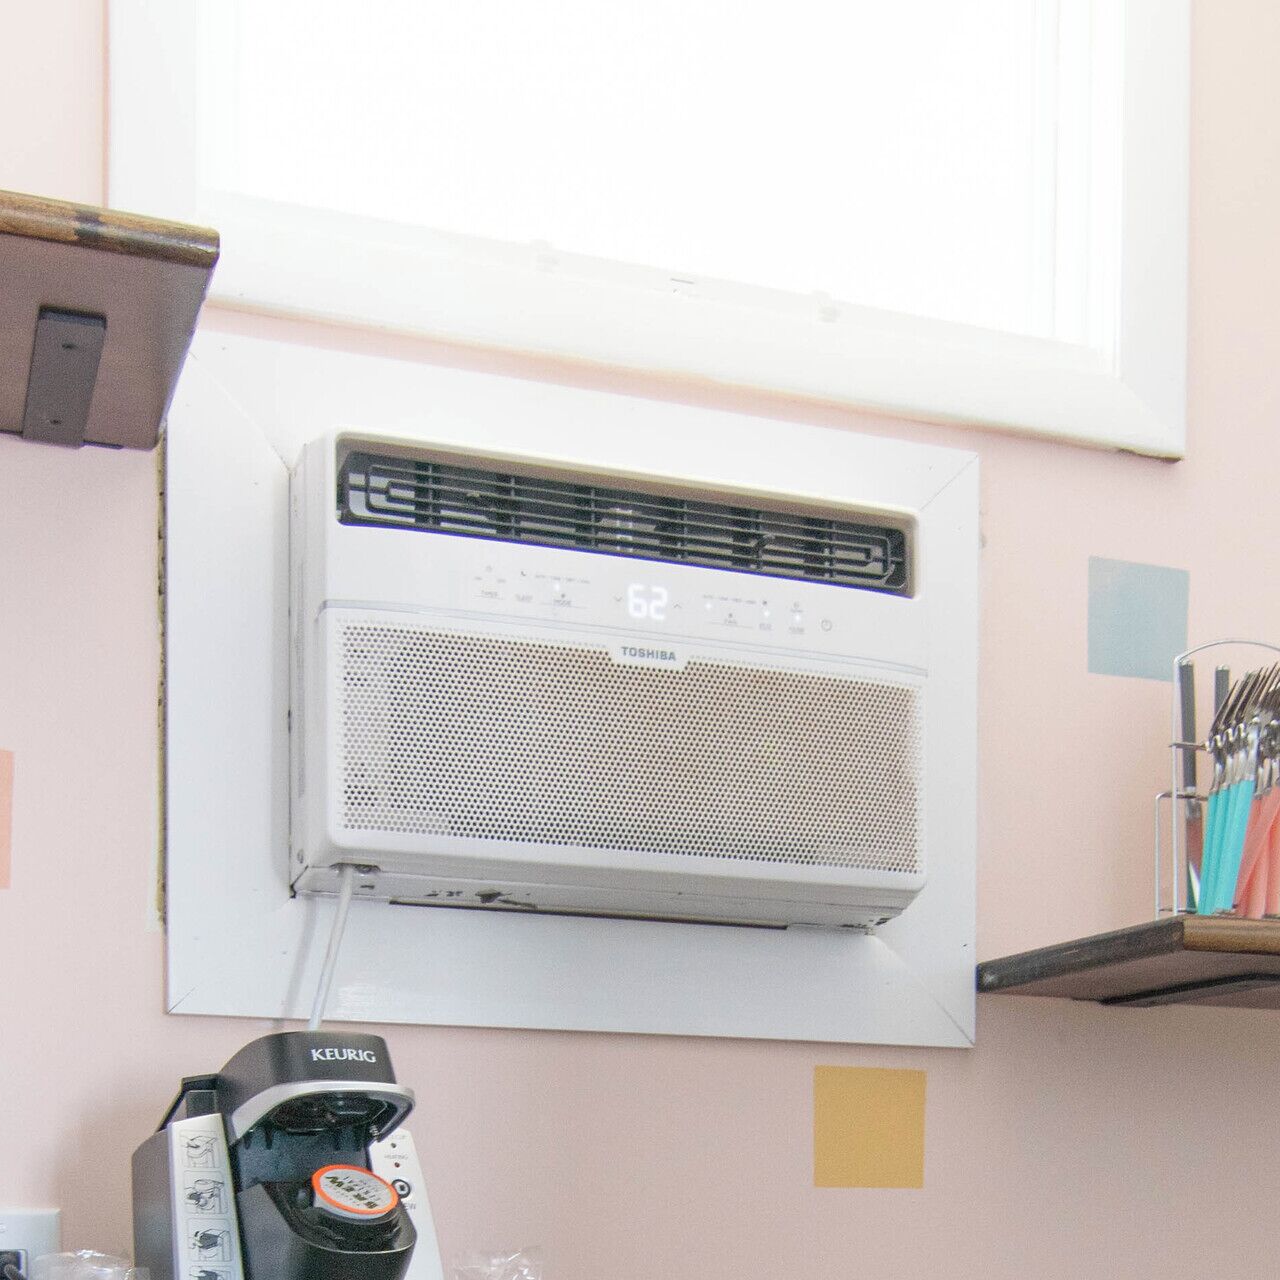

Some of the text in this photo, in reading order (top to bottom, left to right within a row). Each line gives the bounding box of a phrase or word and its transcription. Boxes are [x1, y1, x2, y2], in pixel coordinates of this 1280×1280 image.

[627, 583, 668, 620] 62
[621, 646, 677, 661] TOSHIBA
[311, 1048, 377, 1063] KEURIG
